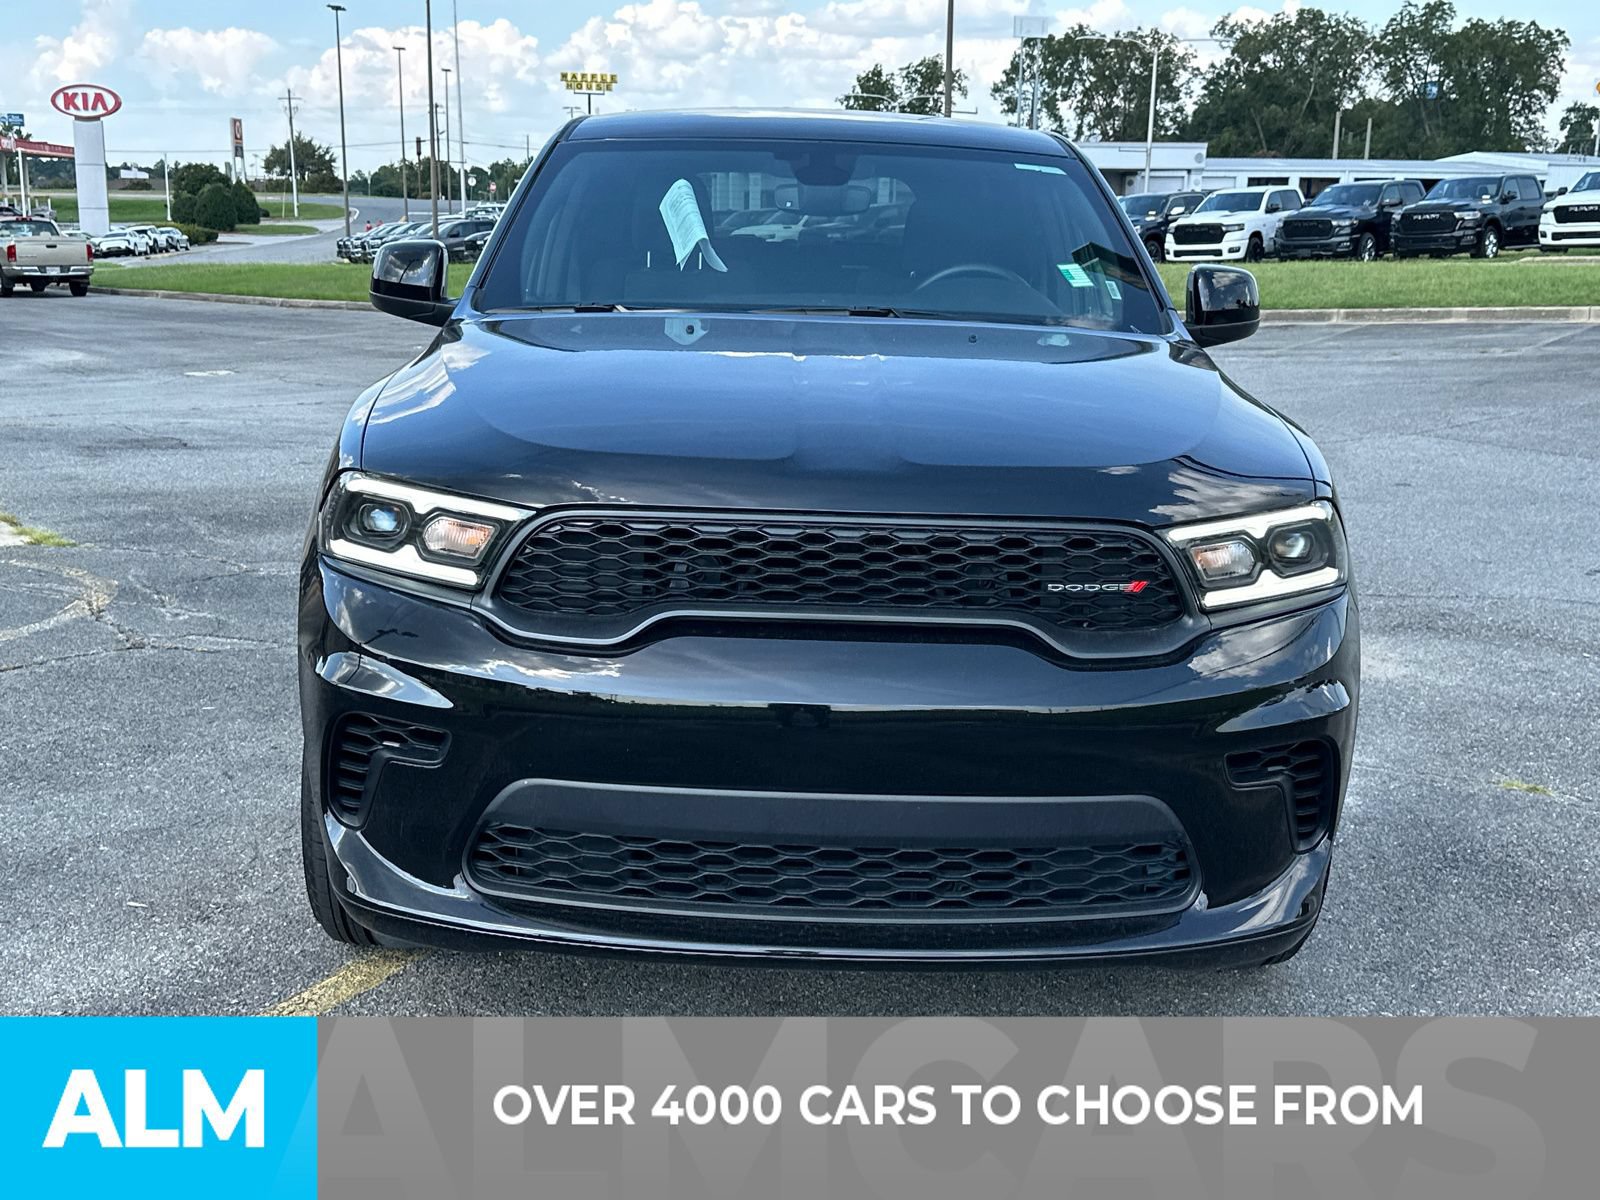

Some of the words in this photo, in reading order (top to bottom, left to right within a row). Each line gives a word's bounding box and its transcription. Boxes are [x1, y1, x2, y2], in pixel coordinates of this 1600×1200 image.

[560, 73, 617, 82] WAFFLE
[566, 82, 612, 91] HOUSE
[63, 92, 109, 112] KIA
[1047, 583, 1134, 592] DODGE
